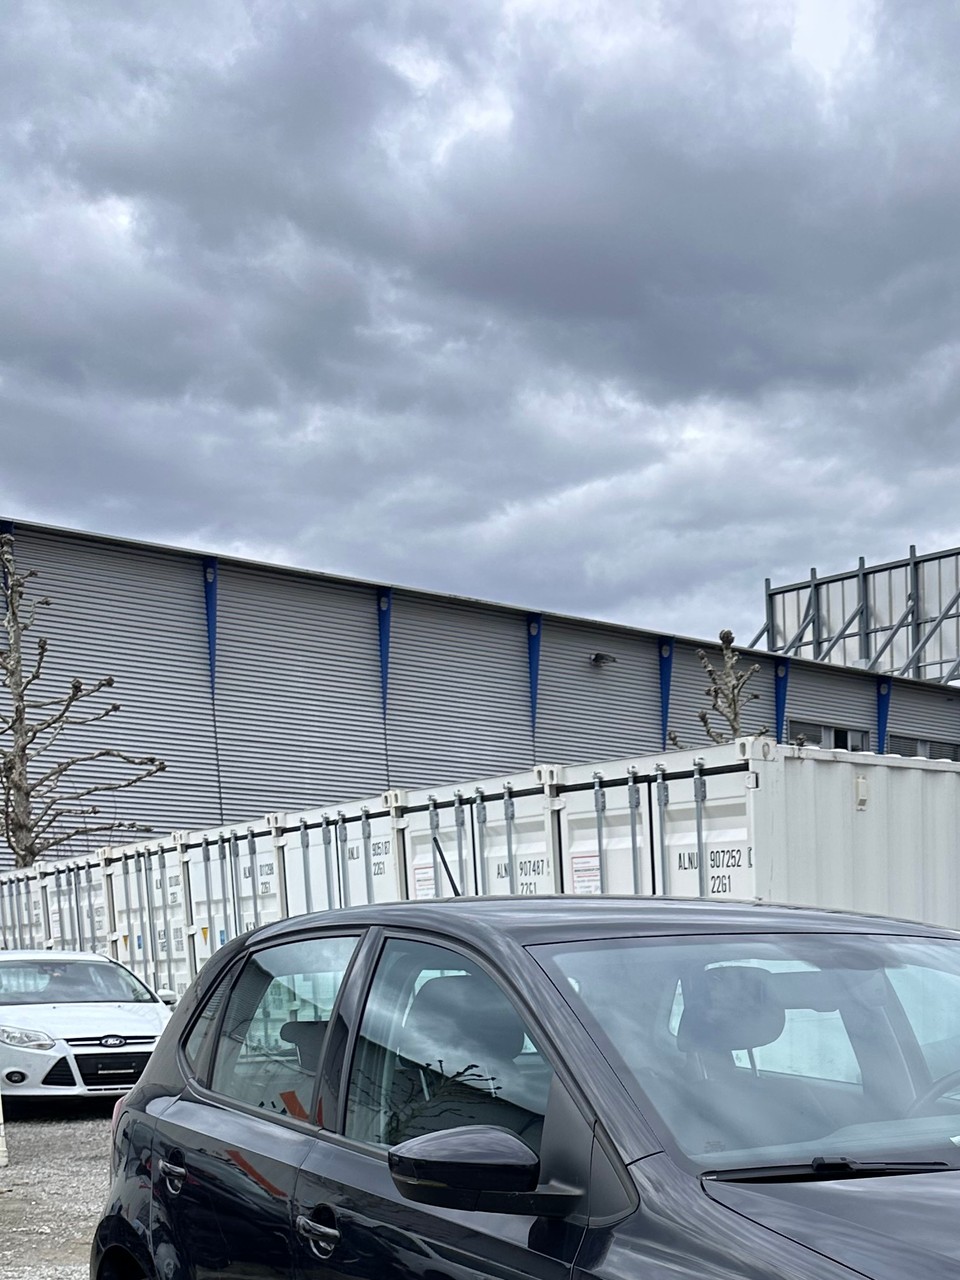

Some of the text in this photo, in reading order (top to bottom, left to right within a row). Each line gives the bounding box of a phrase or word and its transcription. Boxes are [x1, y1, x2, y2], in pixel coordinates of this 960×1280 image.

[497, 863, 510, 879] ALN
[519, 859, 545, 877] 907487
[710, 849, 742, 869] 907252
[711, 874, 732, 894] 22G1
